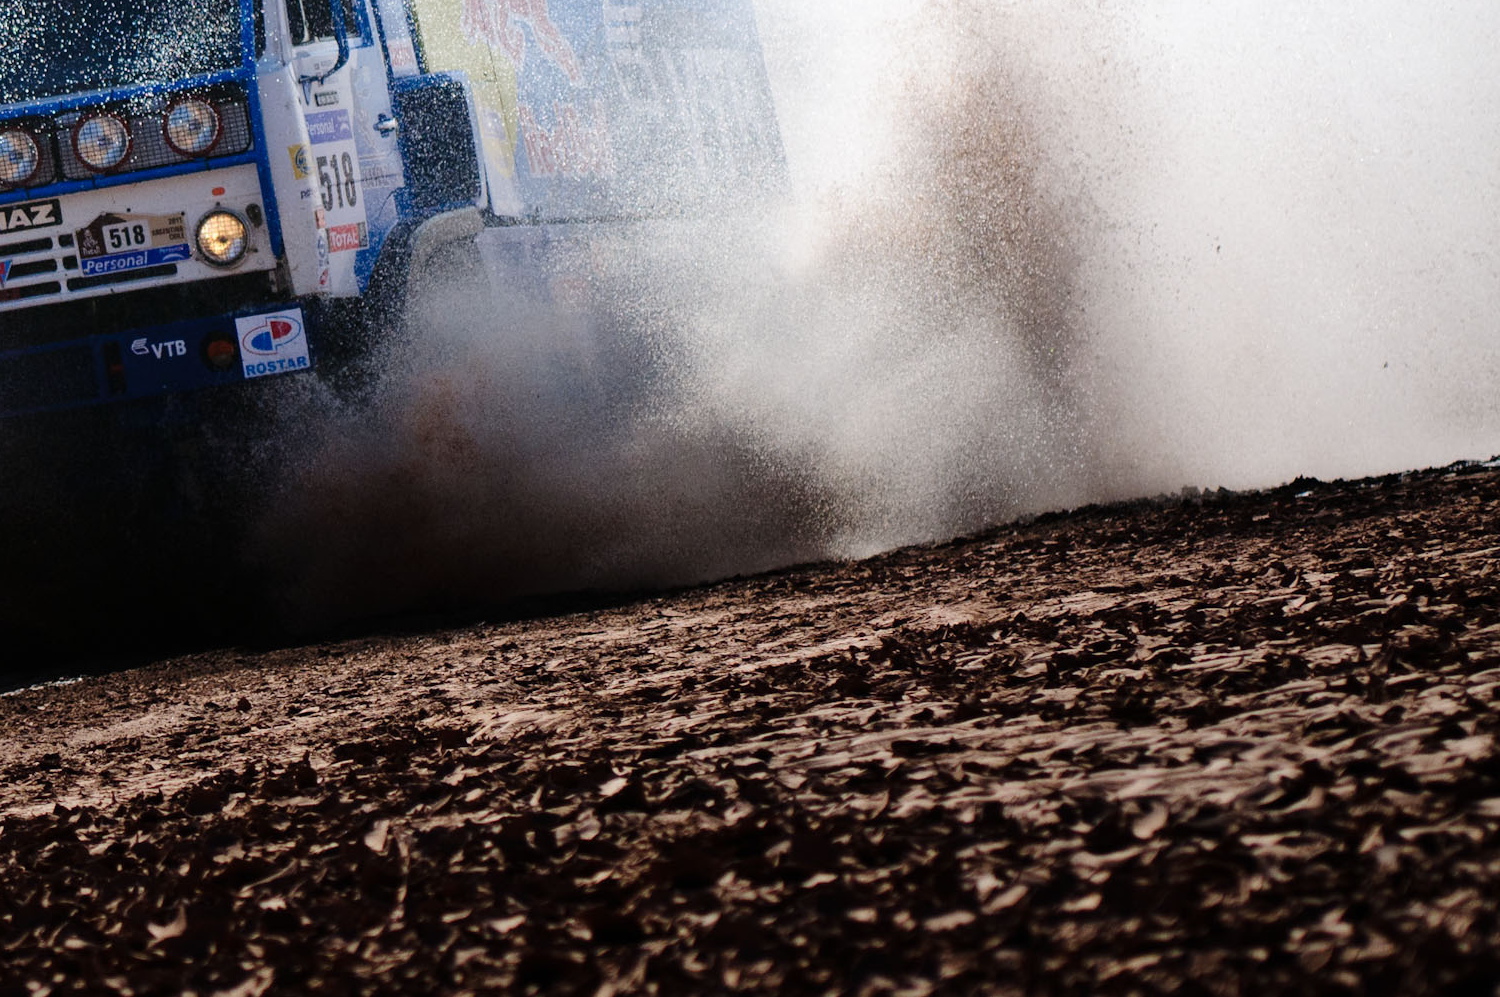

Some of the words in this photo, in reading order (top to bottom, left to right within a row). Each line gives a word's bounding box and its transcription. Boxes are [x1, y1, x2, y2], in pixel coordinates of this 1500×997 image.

[316, 151, 357, 212] 518
[109, 224, 146, 249] 518
[330, 230, 358, 248] TOTAL
[86, 251, 148, 273] Personal
[151, 339, 187, 360] VTB
[245, 355, 308, 377] ROSTAR
